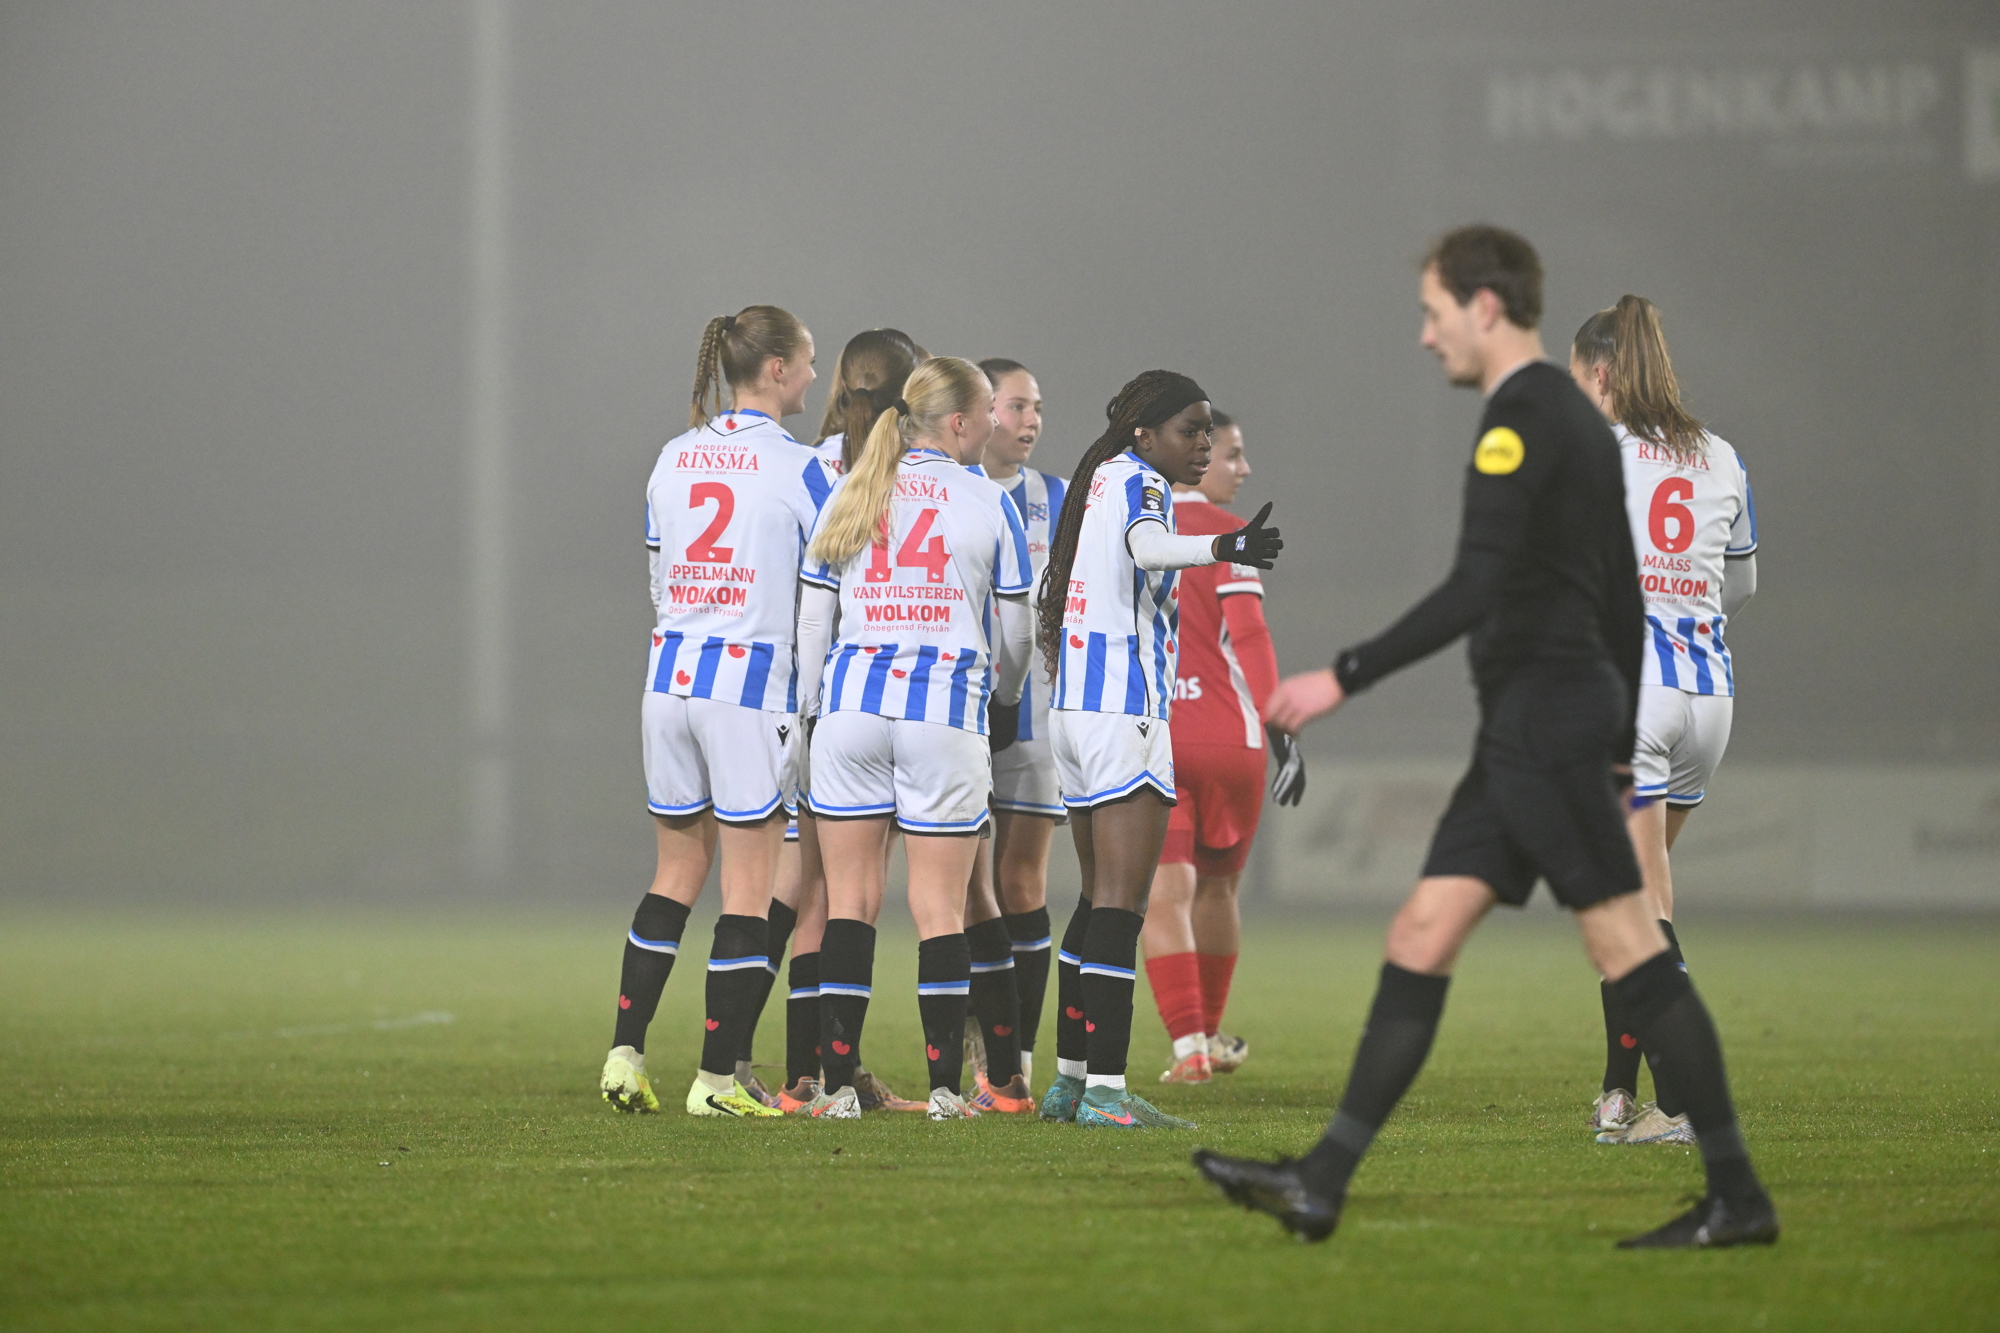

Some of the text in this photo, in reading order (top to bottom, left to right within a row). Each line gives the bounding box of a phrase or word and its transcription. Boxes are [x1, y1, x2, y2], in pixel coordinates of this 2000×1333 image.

[1486, 66, 1940, 138] HOGENKAMP
[695, 444, 749, 452] MODEPLEIN
[676, 452, 759, 471] RINSMA
[893, 480, 949, 502] NSMA
[685, 482, 735, 564] 2
[1648, 477, 1695, 554] 6
[865, 508, 952, 583] 14
[1642, 554, 1691, 572] MAASS
[853, 586, 964, 601] VAN VILSTEREN
[865, 605, 950, 623] WOLKOM
[863, 624, 950, 633] Onbegrensd Fryslân
